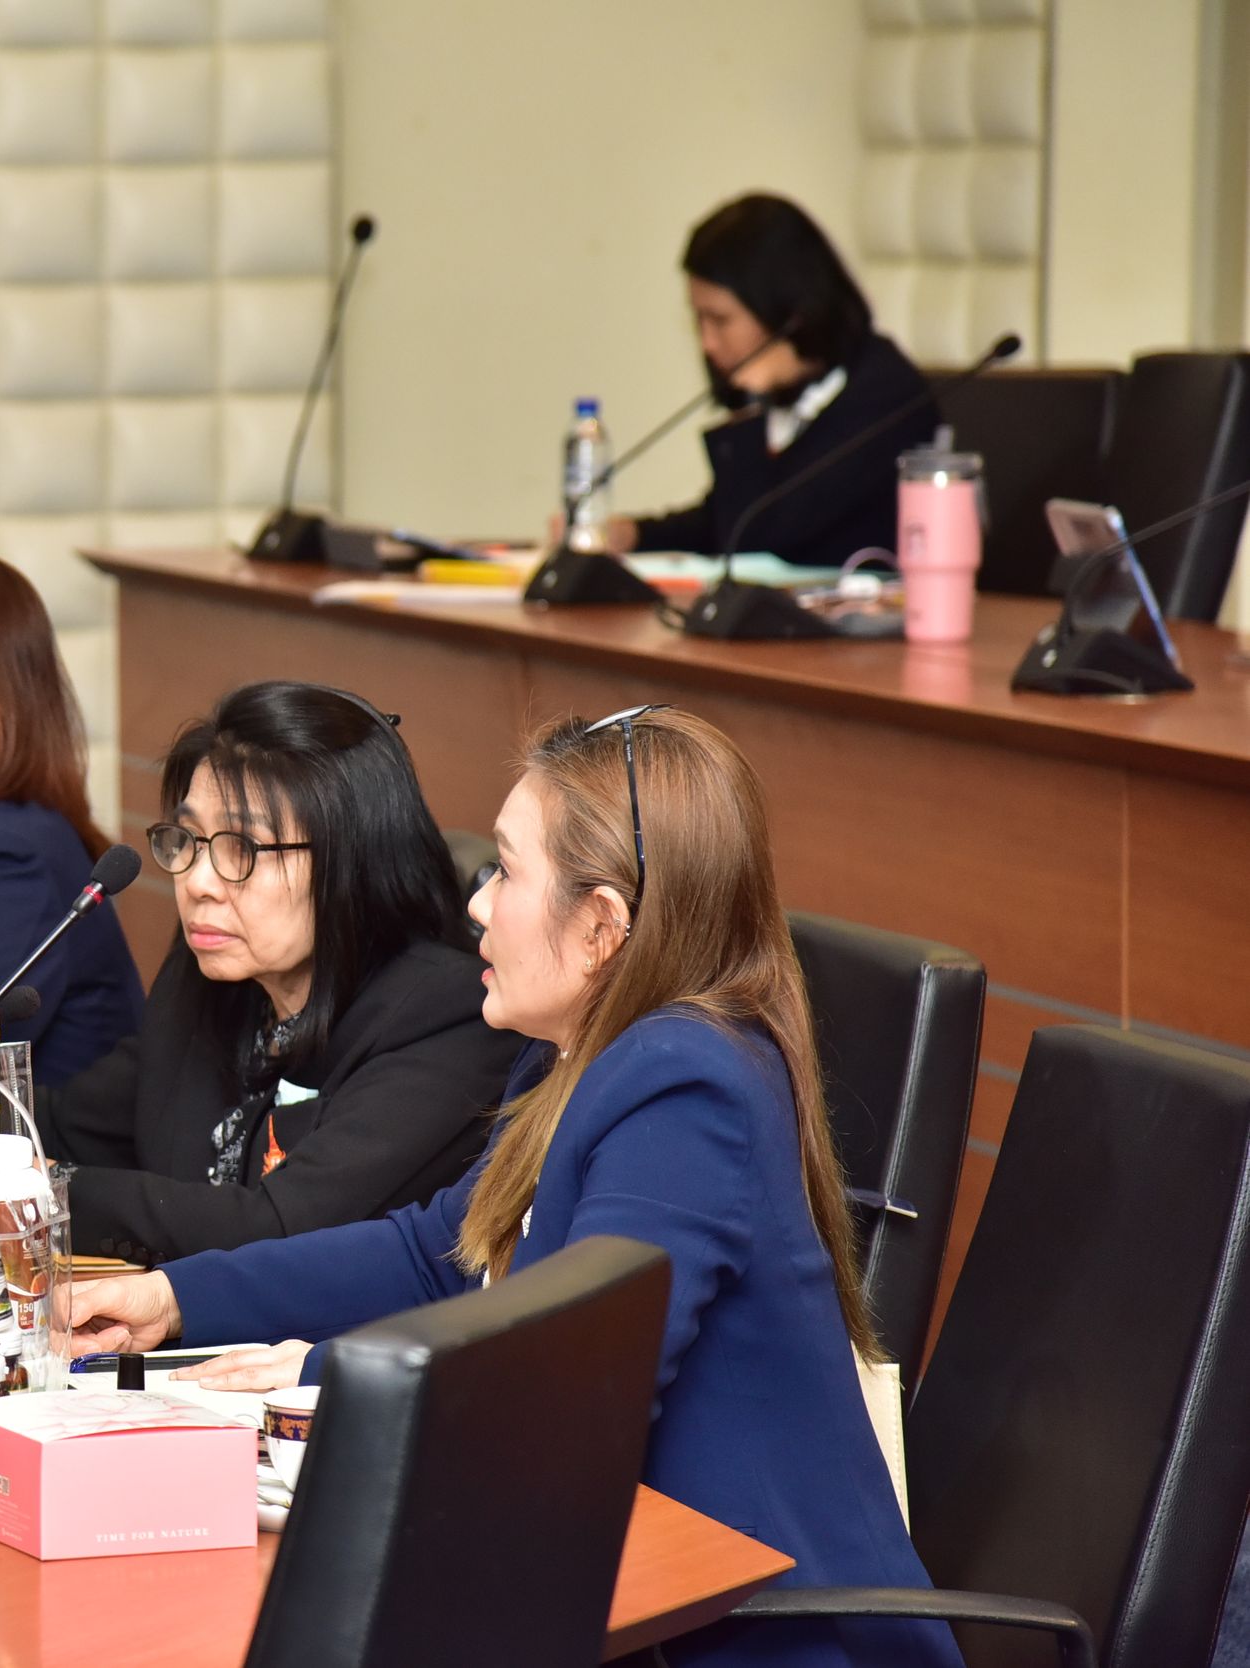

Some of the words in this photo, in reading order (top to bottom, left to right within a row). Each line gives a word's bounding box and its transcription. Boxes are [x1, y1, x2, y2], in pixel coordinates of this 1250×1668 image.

[18, 1302, 34, 1314] 150
[96, 1532, 126, 1543] TIME
[132, 1530, 155, 1541] FOR
[161, 1527, 210, 1539] NATURE
